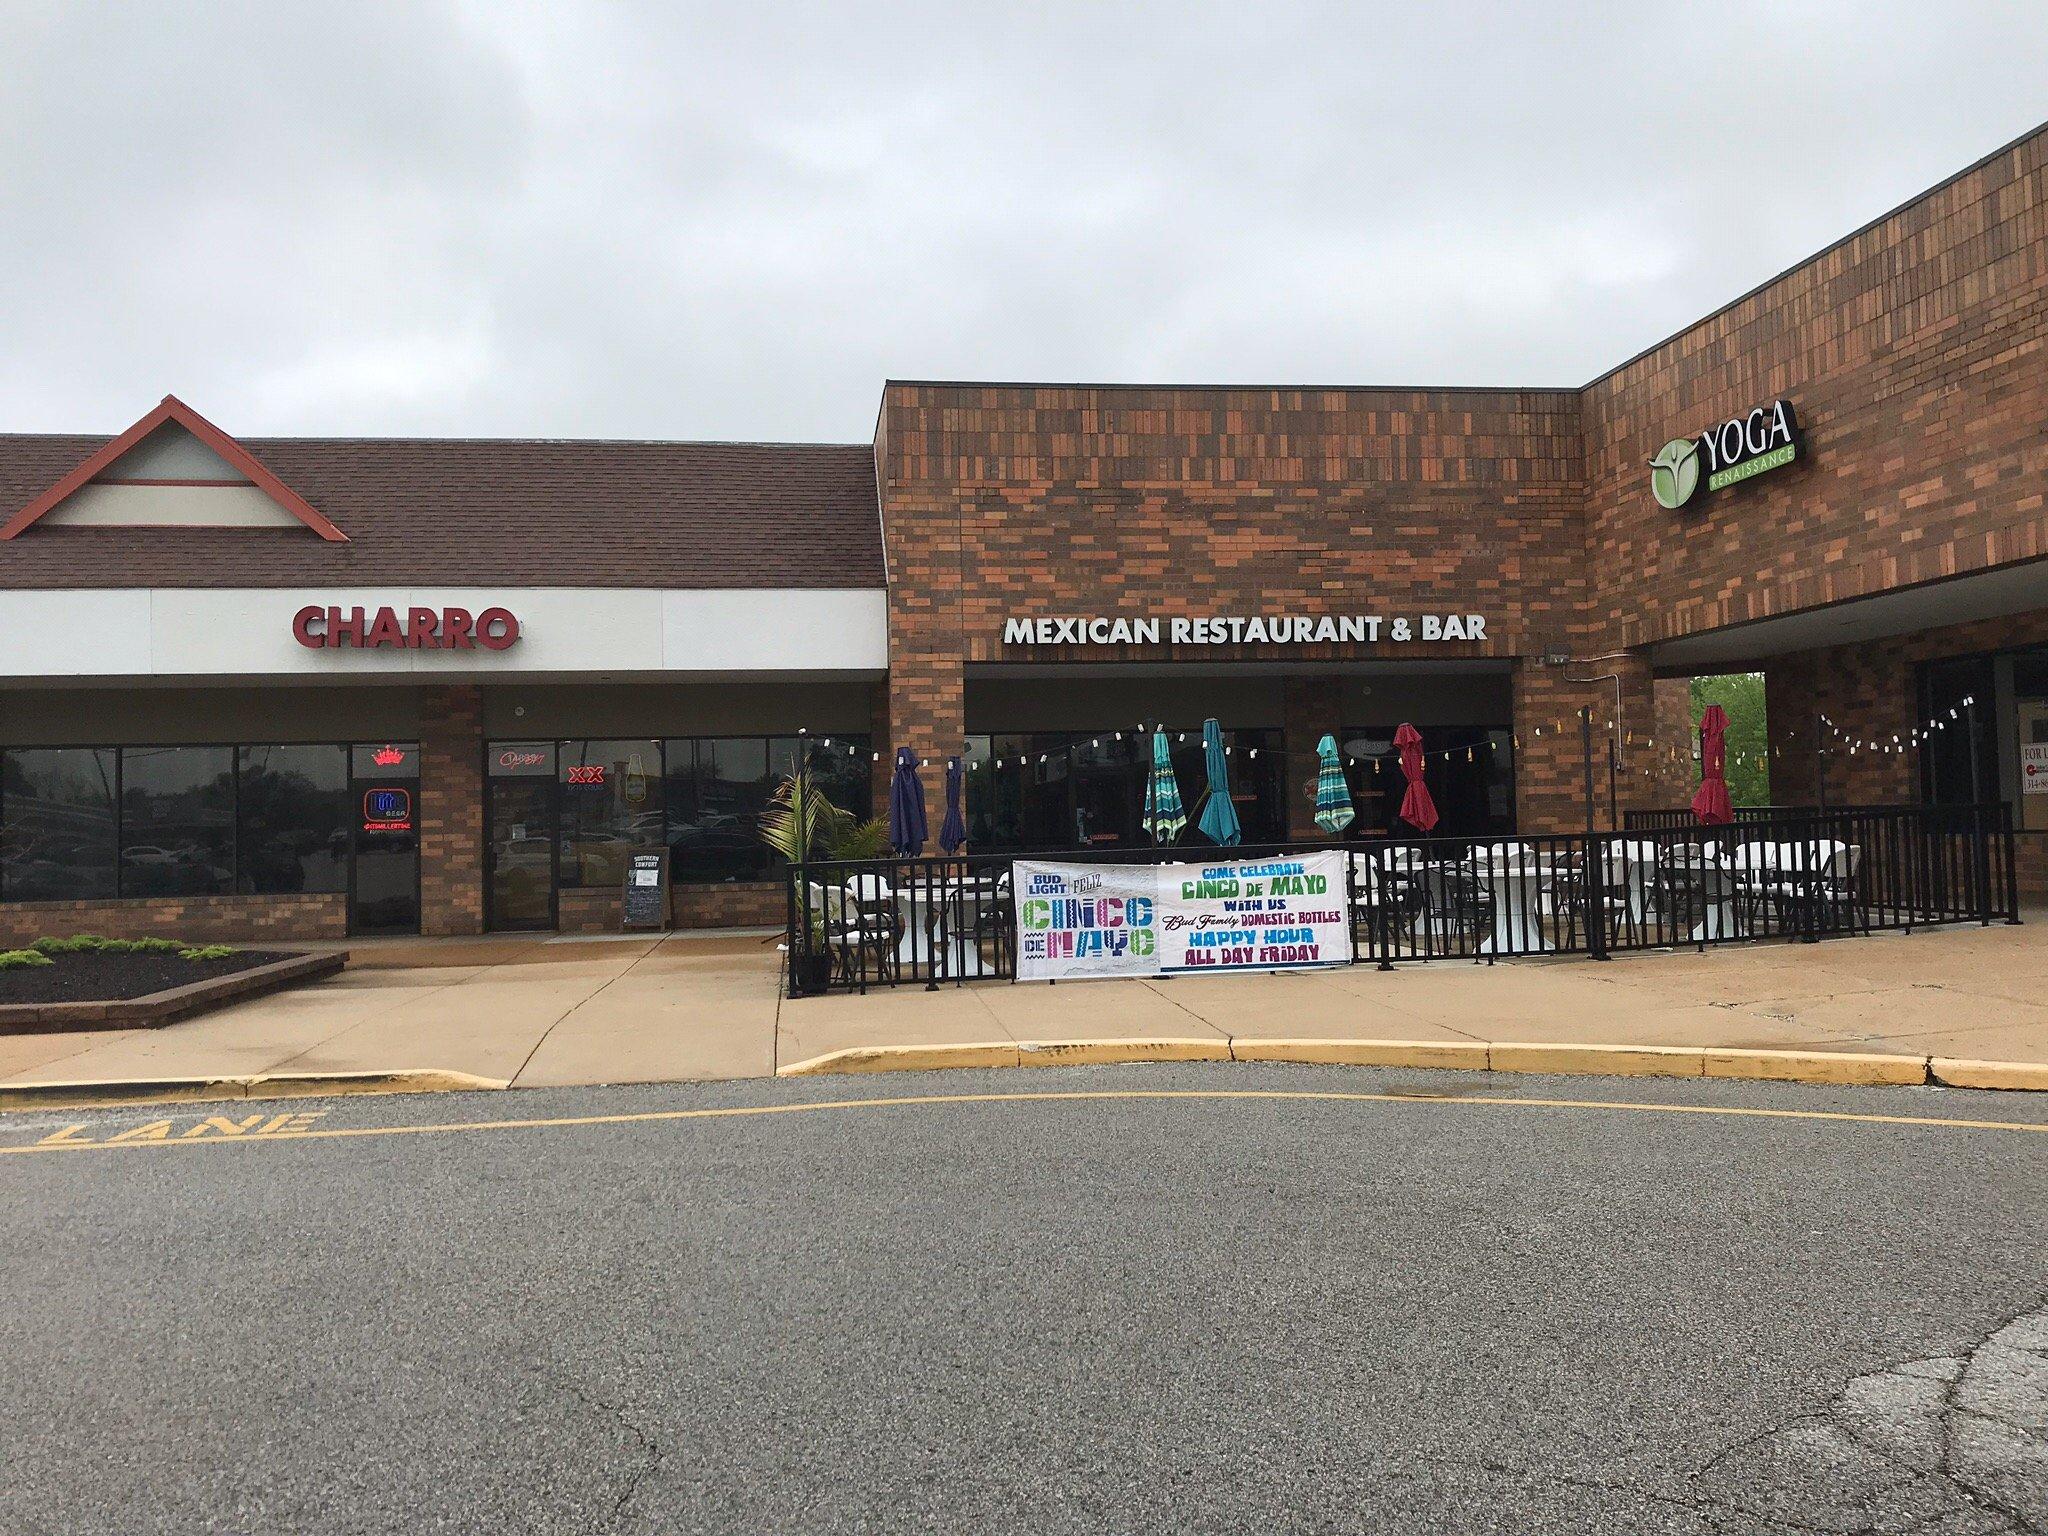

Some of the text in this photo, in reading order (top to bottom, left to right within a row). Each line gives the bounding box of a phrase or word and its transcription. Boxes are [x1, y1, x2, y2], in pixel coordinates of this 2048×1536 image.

[1702, 400, 1792, 471] YOGA
[1711, 447, 1794, 489] RENAISSANCE
[292, 605, 520, 651] CHARRO
[1003, 614, 1488, 645] MEXICAN RESTAURANT & BAR
[2024, 747, 2042, 760] FOR
[568, 766, 605, 783] XX
[1033, 874, 1062, 885] BUD
[1202, 862, 1305, 880] COME CELEBRATE
[1028, 884, 1067, 895] LIGHT
[1073, 874, 1102, 894] FELIZ
[1181, 875, 1327, 900] CINCO DE MAYO
[1022, 896, 1153, 930] CINCO
[1268, 898, 1287, 910] US
[1162, 914, 1196, 931] Bud
[1196, 914, 1240, 930] Family
[1298, 910, 1341, 924] BOTTLES
[1024, 928, 1155, 959] DE MAYO
[1189, 927, 1315, 947] HAPPY HOUR
[1184, 948, 1217, 966] ALL
[1221, 946, 1254, 965] DAY
[35, 1111, 329, 1147] LANE
